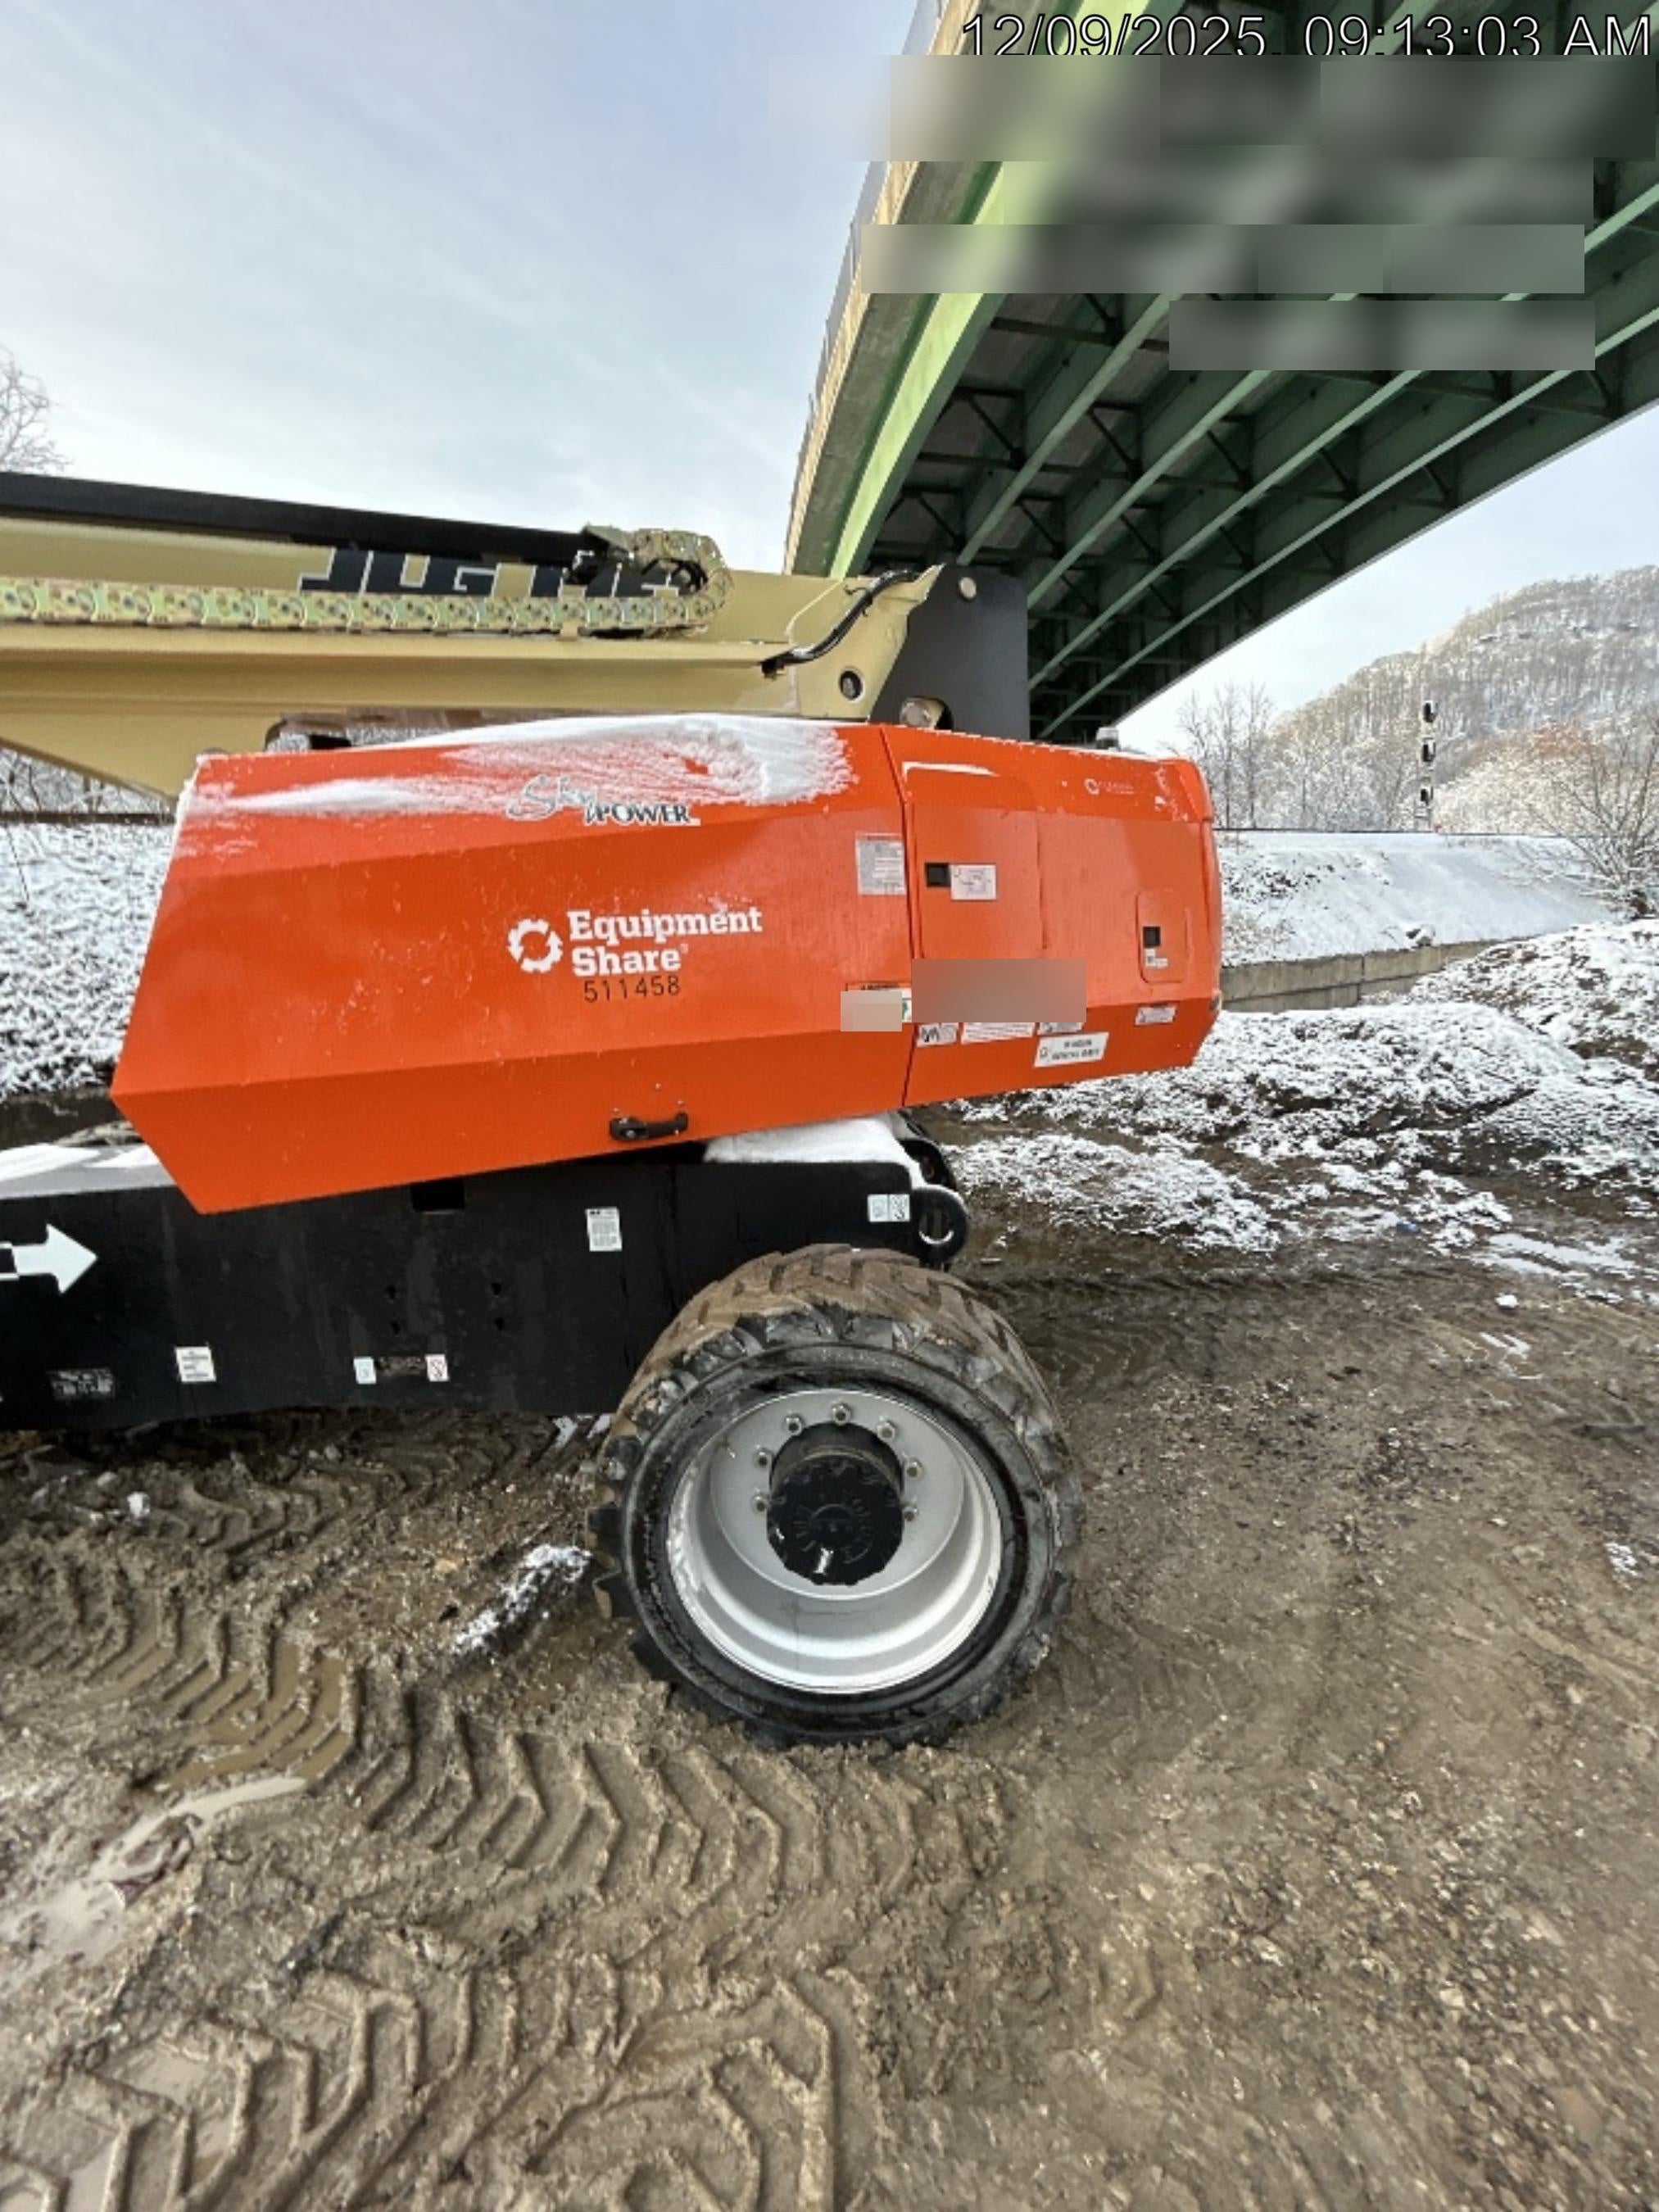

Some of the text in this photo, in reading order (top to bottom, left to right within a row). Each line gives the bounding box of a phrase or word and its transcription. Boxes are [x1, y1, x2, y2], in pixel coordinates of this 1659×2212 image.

[567, 906, 763, 945] Equipment
[572, 946, 682, 977] Share
[583, 976, 681, 1002] 511458
